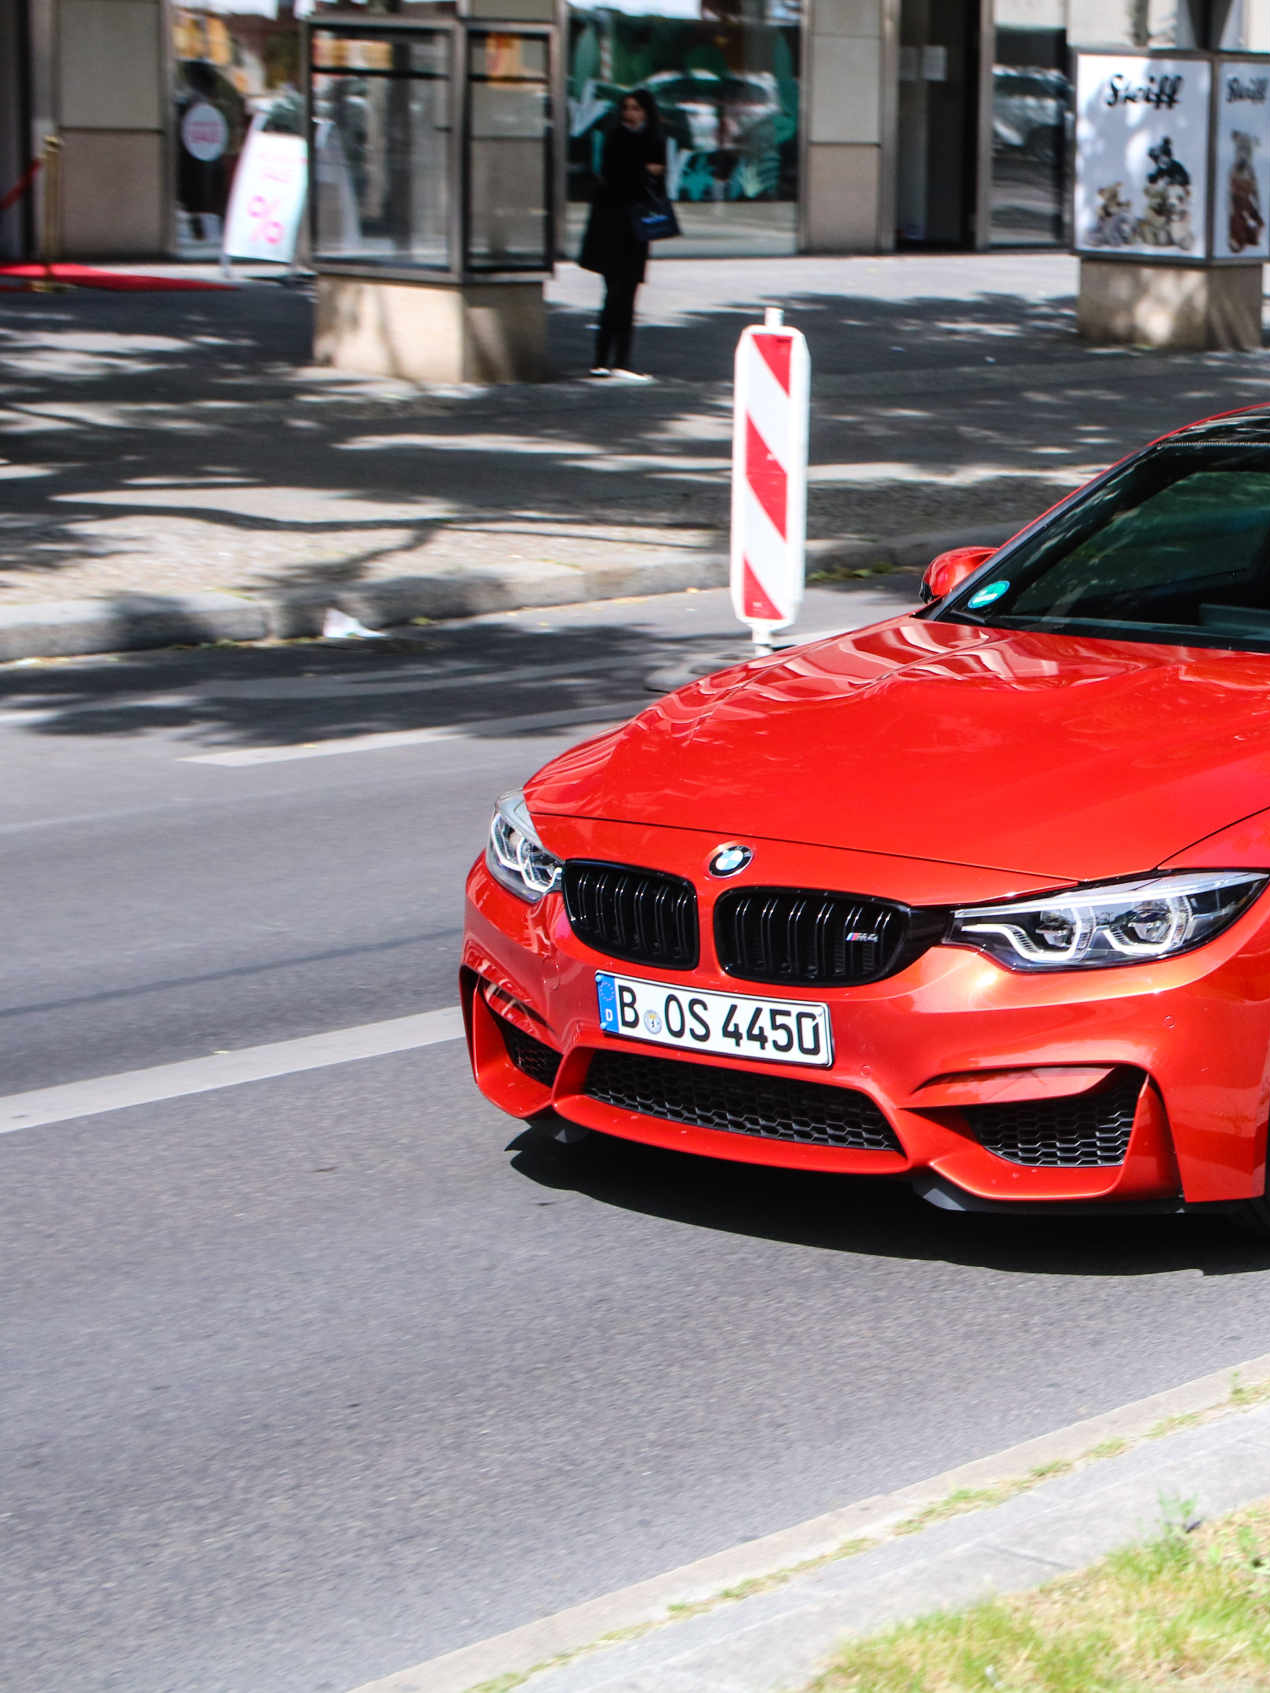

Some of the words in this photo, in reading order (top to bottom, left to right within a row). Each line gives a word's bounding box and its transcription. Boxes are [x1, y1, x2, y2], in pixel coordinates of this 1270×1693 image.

[1106, 74, 1184, 110] Steiff
[605, 1008, 613, 1021] D
[618, 985, 640, 1029] B
[664, 993, 711, 1042] OS
[721, 1003, 821, 1056] 4450
